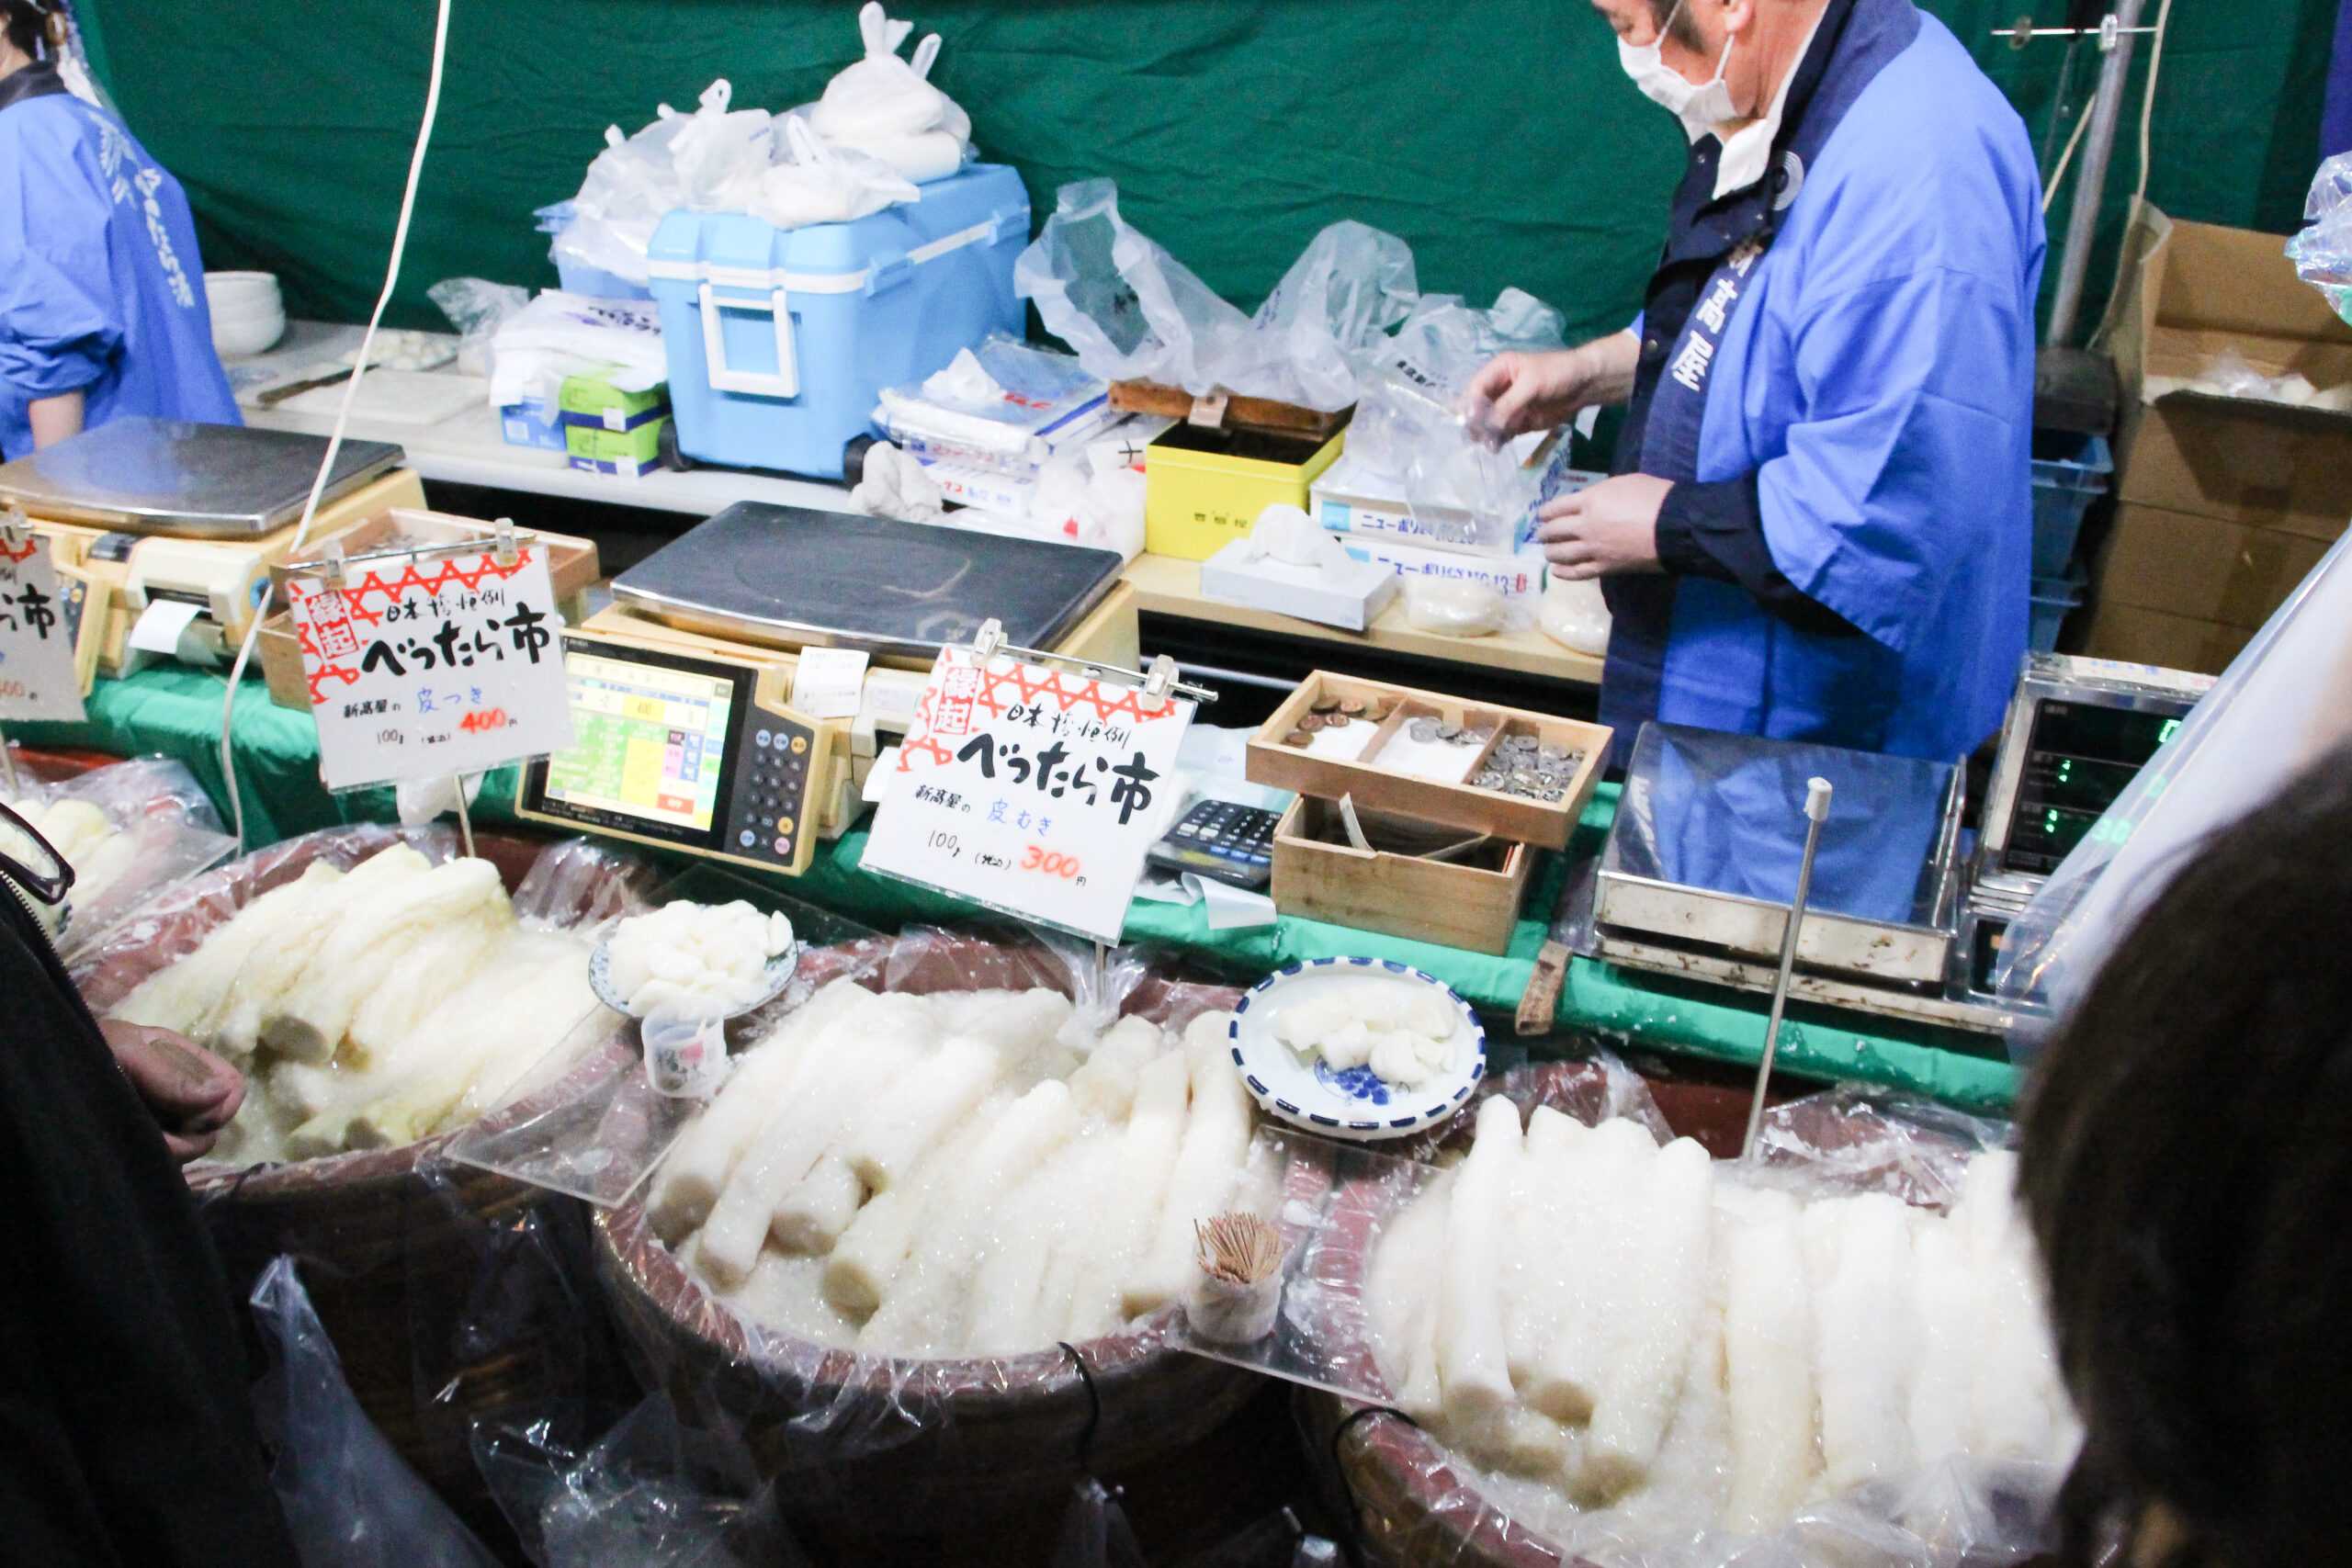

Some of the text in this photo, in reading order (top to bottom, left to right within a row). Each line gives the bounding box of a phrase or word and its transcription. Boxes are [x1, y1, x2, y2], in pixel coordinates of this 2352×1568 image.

[307, 591, 357, 660] 縁起
[362, 602, 549, 675] べったら市
[933, 668, 980, 734] 縁起
[957, 733, 1160, 825] べったら市
[988, 799, 1051, 836] 皮むき
